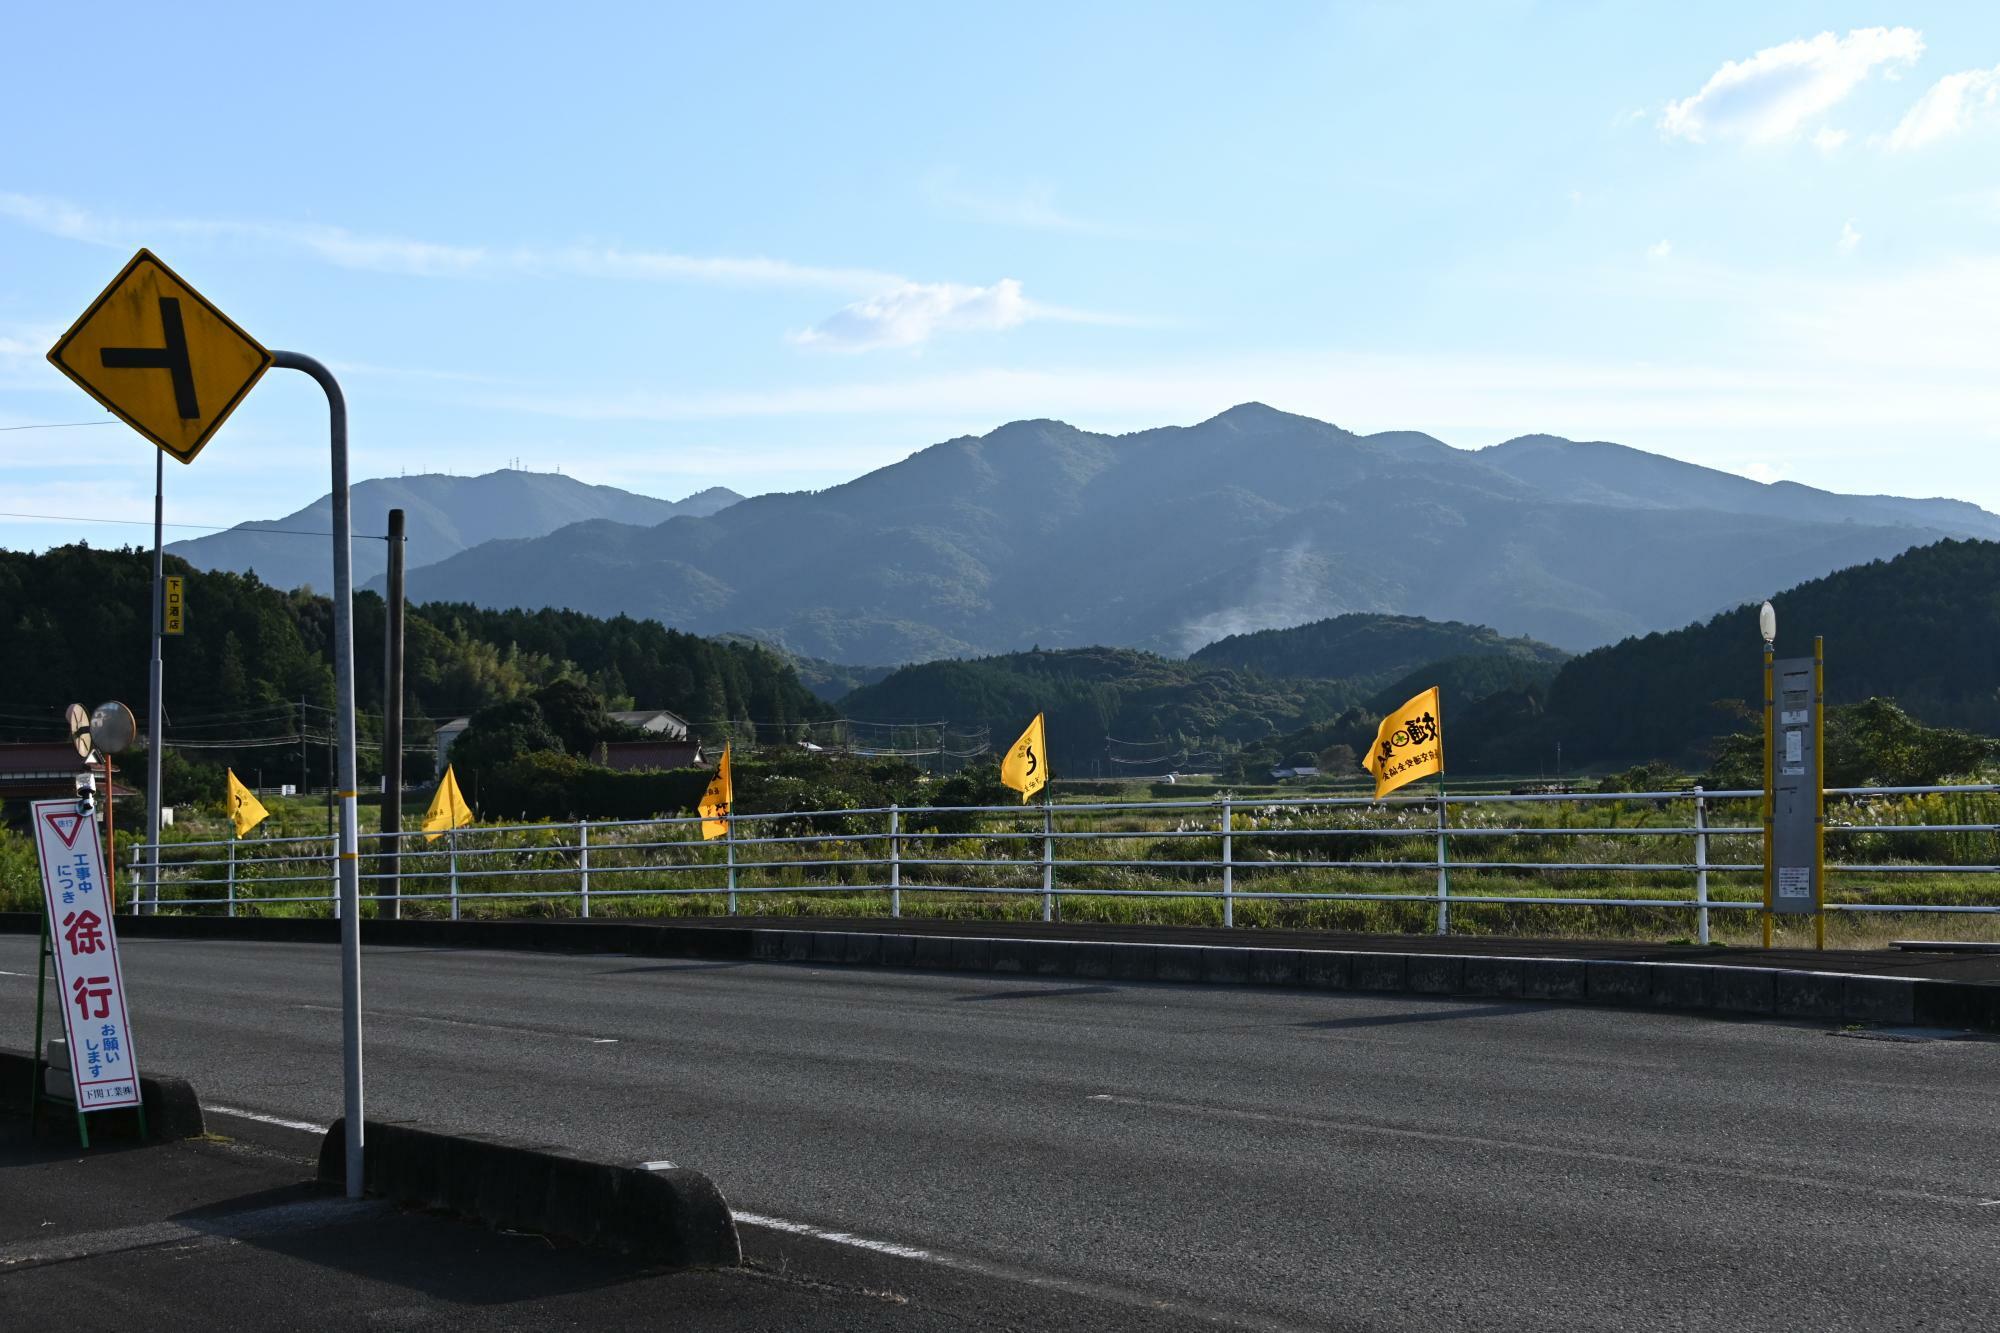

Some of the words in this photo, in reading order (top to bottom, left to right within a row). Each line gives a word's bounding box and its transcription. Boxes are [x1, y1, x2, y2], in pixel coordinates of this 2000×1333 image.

[58, 865, 75, 904] につき
[73, 853, 93, 893] 工事中
[62, 909, 113, 1021] 徐行
[85, 1038, 102, 1078] します
[101, 1024, 120, 1064] お願い
